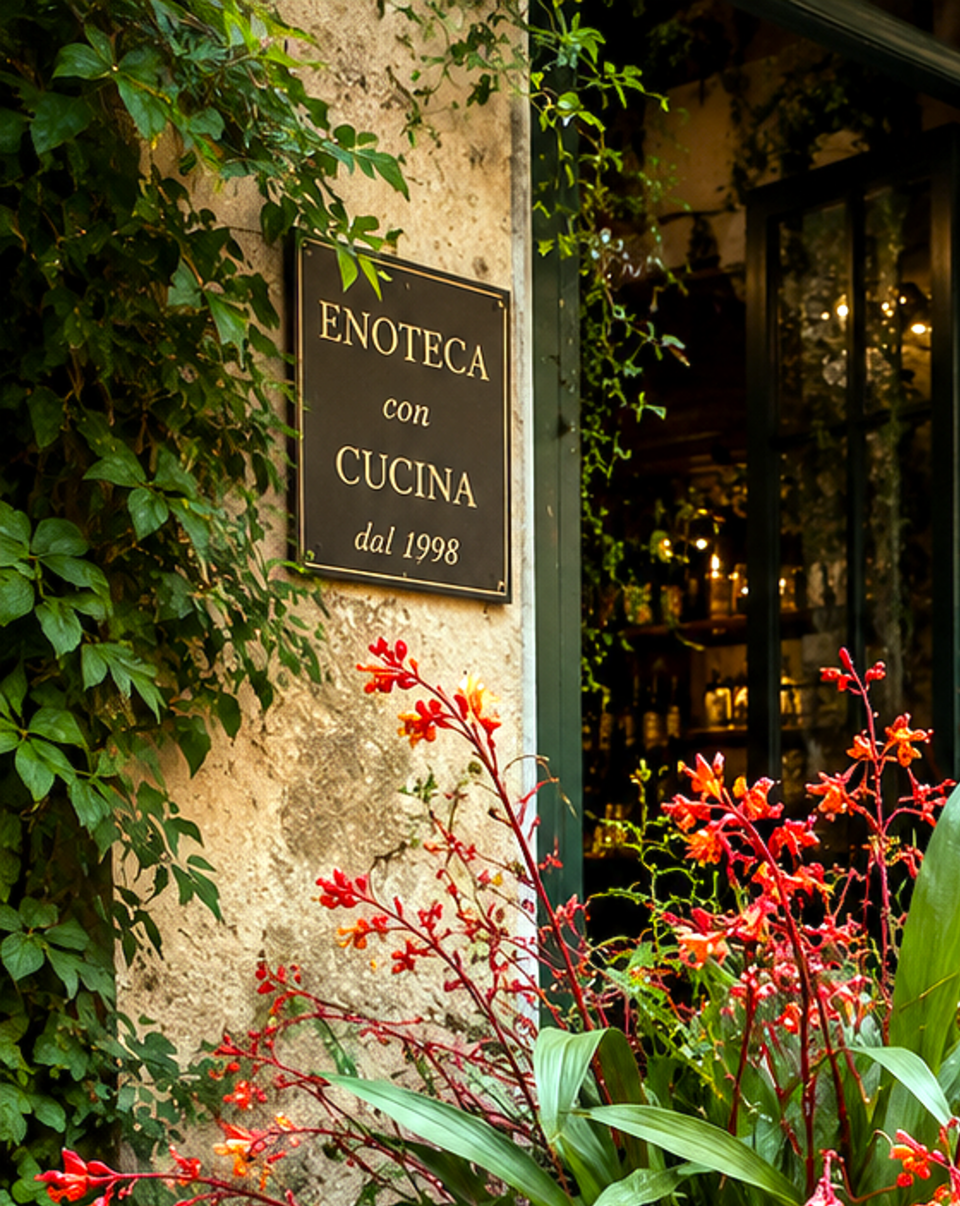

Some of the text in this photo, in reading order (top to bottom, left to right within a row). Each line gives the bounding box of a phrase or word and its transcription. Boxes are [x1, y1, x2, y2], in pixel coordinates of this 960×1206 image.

[319, 300, 490, 381] ENOTECA
[382, 398, 430, 427] con
[335, 445, 478, 508] CUCINA
[354, 521, 461, 566] dal 1998
